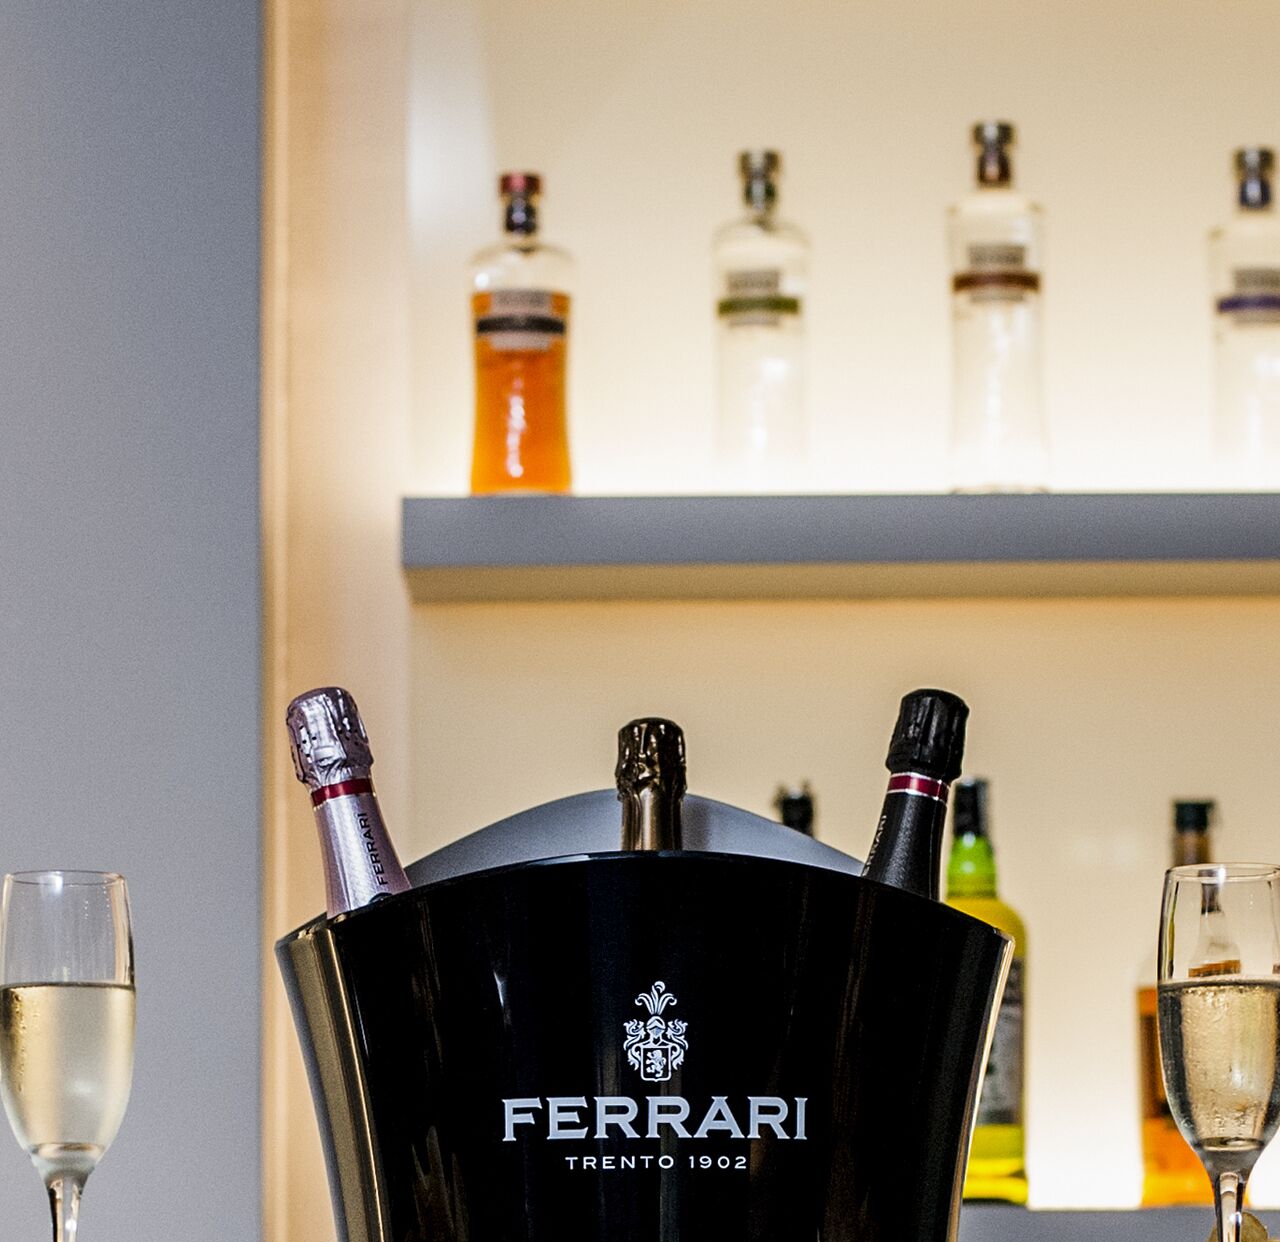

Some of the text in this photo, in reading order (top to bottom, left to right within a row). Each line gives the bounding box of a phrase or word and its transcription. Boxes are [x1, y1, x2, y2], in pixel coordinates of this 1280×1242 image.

[357, 812, 389, 886] FERRARI
[501, 1095, 808, 1142] FERRARI
[565, 1155, 747, 1170] TRENTO 1902
